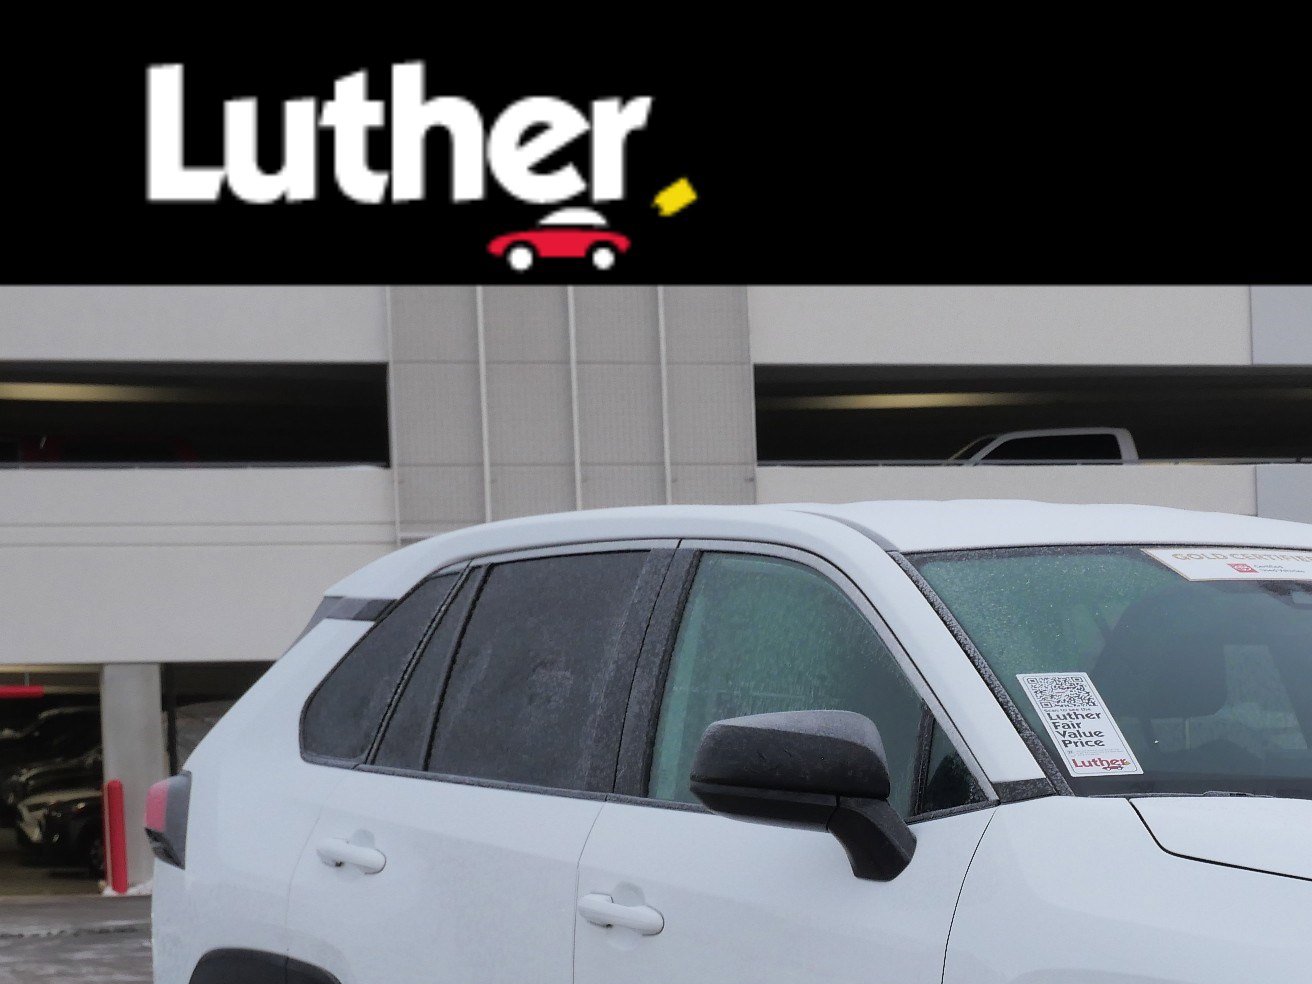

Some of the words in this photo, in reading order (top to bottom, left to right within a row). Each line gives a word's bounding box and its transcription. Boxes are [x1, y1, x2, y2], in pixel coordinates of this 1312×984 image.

[1172, 553, 1228, 561] GOLD
[1047, 711, 1102, 721] Luther
[1052, 721, 1082, 730] Fair
[1055, 729, 1105, 739] Value
[1061, 738, 1106, 748] Price
[1072, 757, 1127, 768] Luther
